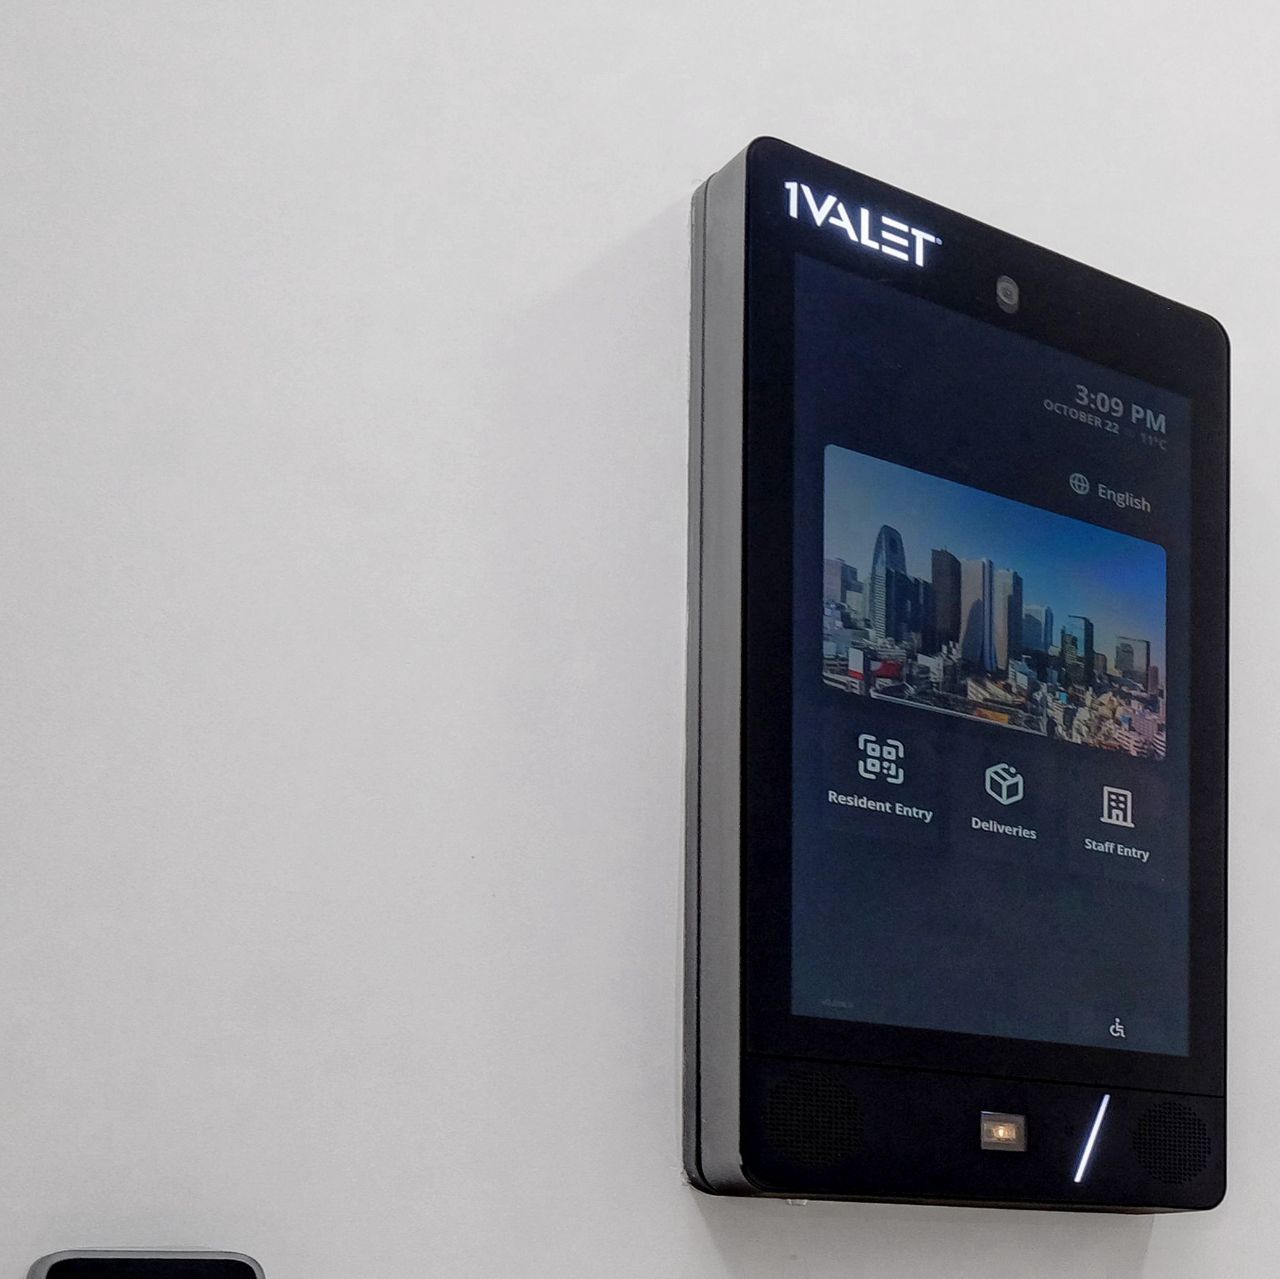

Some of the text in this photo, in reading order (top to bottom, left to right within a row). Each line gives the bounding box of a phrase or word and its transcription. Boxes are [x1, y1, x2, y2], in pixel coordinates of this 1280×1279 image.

[784, 181, 936, 267] 1VALET
[1043, 399, 1102, 429] OCTOBER
[1104, 419, 1120, 434] 22
[1075, 384, 1167, 434] 3:09 PM
[1097, 483, 1151, 513] English
[828, 790, 933, 823] Resident Entry
[971, 816, 1038, 840] Deliveries
[1084, 838, 1150, 863] Staff Entry
